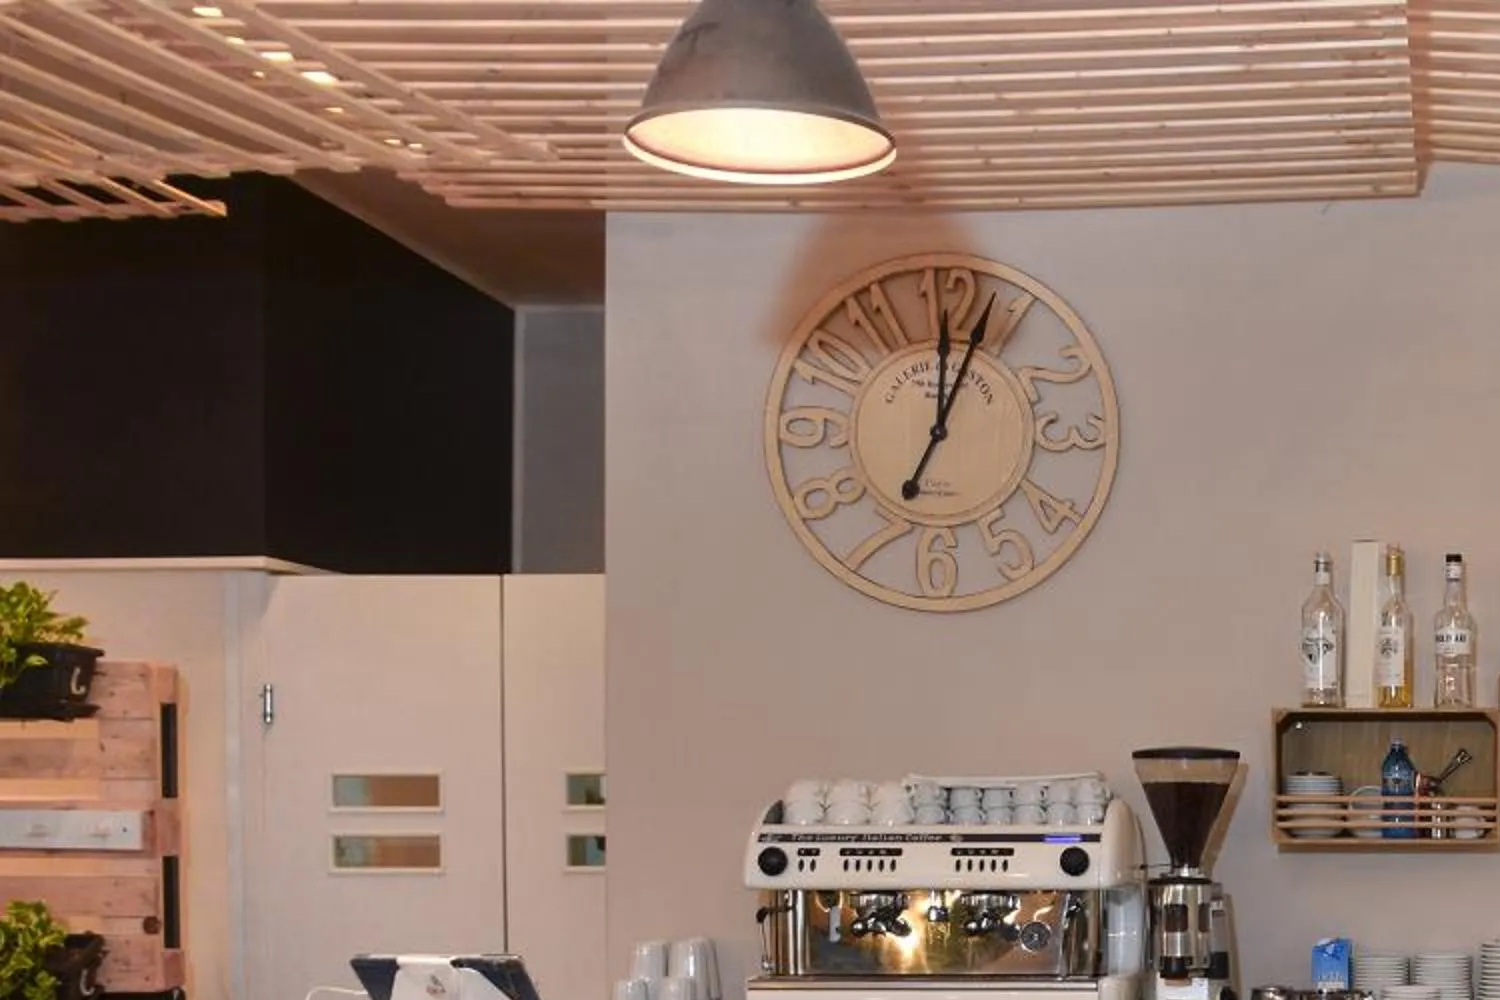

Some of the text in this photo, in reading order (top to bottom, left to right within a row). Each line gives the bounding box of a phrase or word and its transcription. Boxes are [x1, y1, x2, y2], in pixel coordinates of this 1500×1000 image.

[846, 283, 911, 356] 11
[918, 267, 977, 346] 12
[992, 296, 1037, 355] 1
[794, 330, 875, 398] 10
[1015, 345, 1094, 404] 2
[780, 405, 851, 449] 9
[1035, 413, 1107, 453] 3
[795, 466, 868, 521] 8
[1020, 477, 1089, 535] 4
[845, 504, 914, 571] 7
[915, 527, 958, 598] 6
[977, 506, 1035, 582] 5
